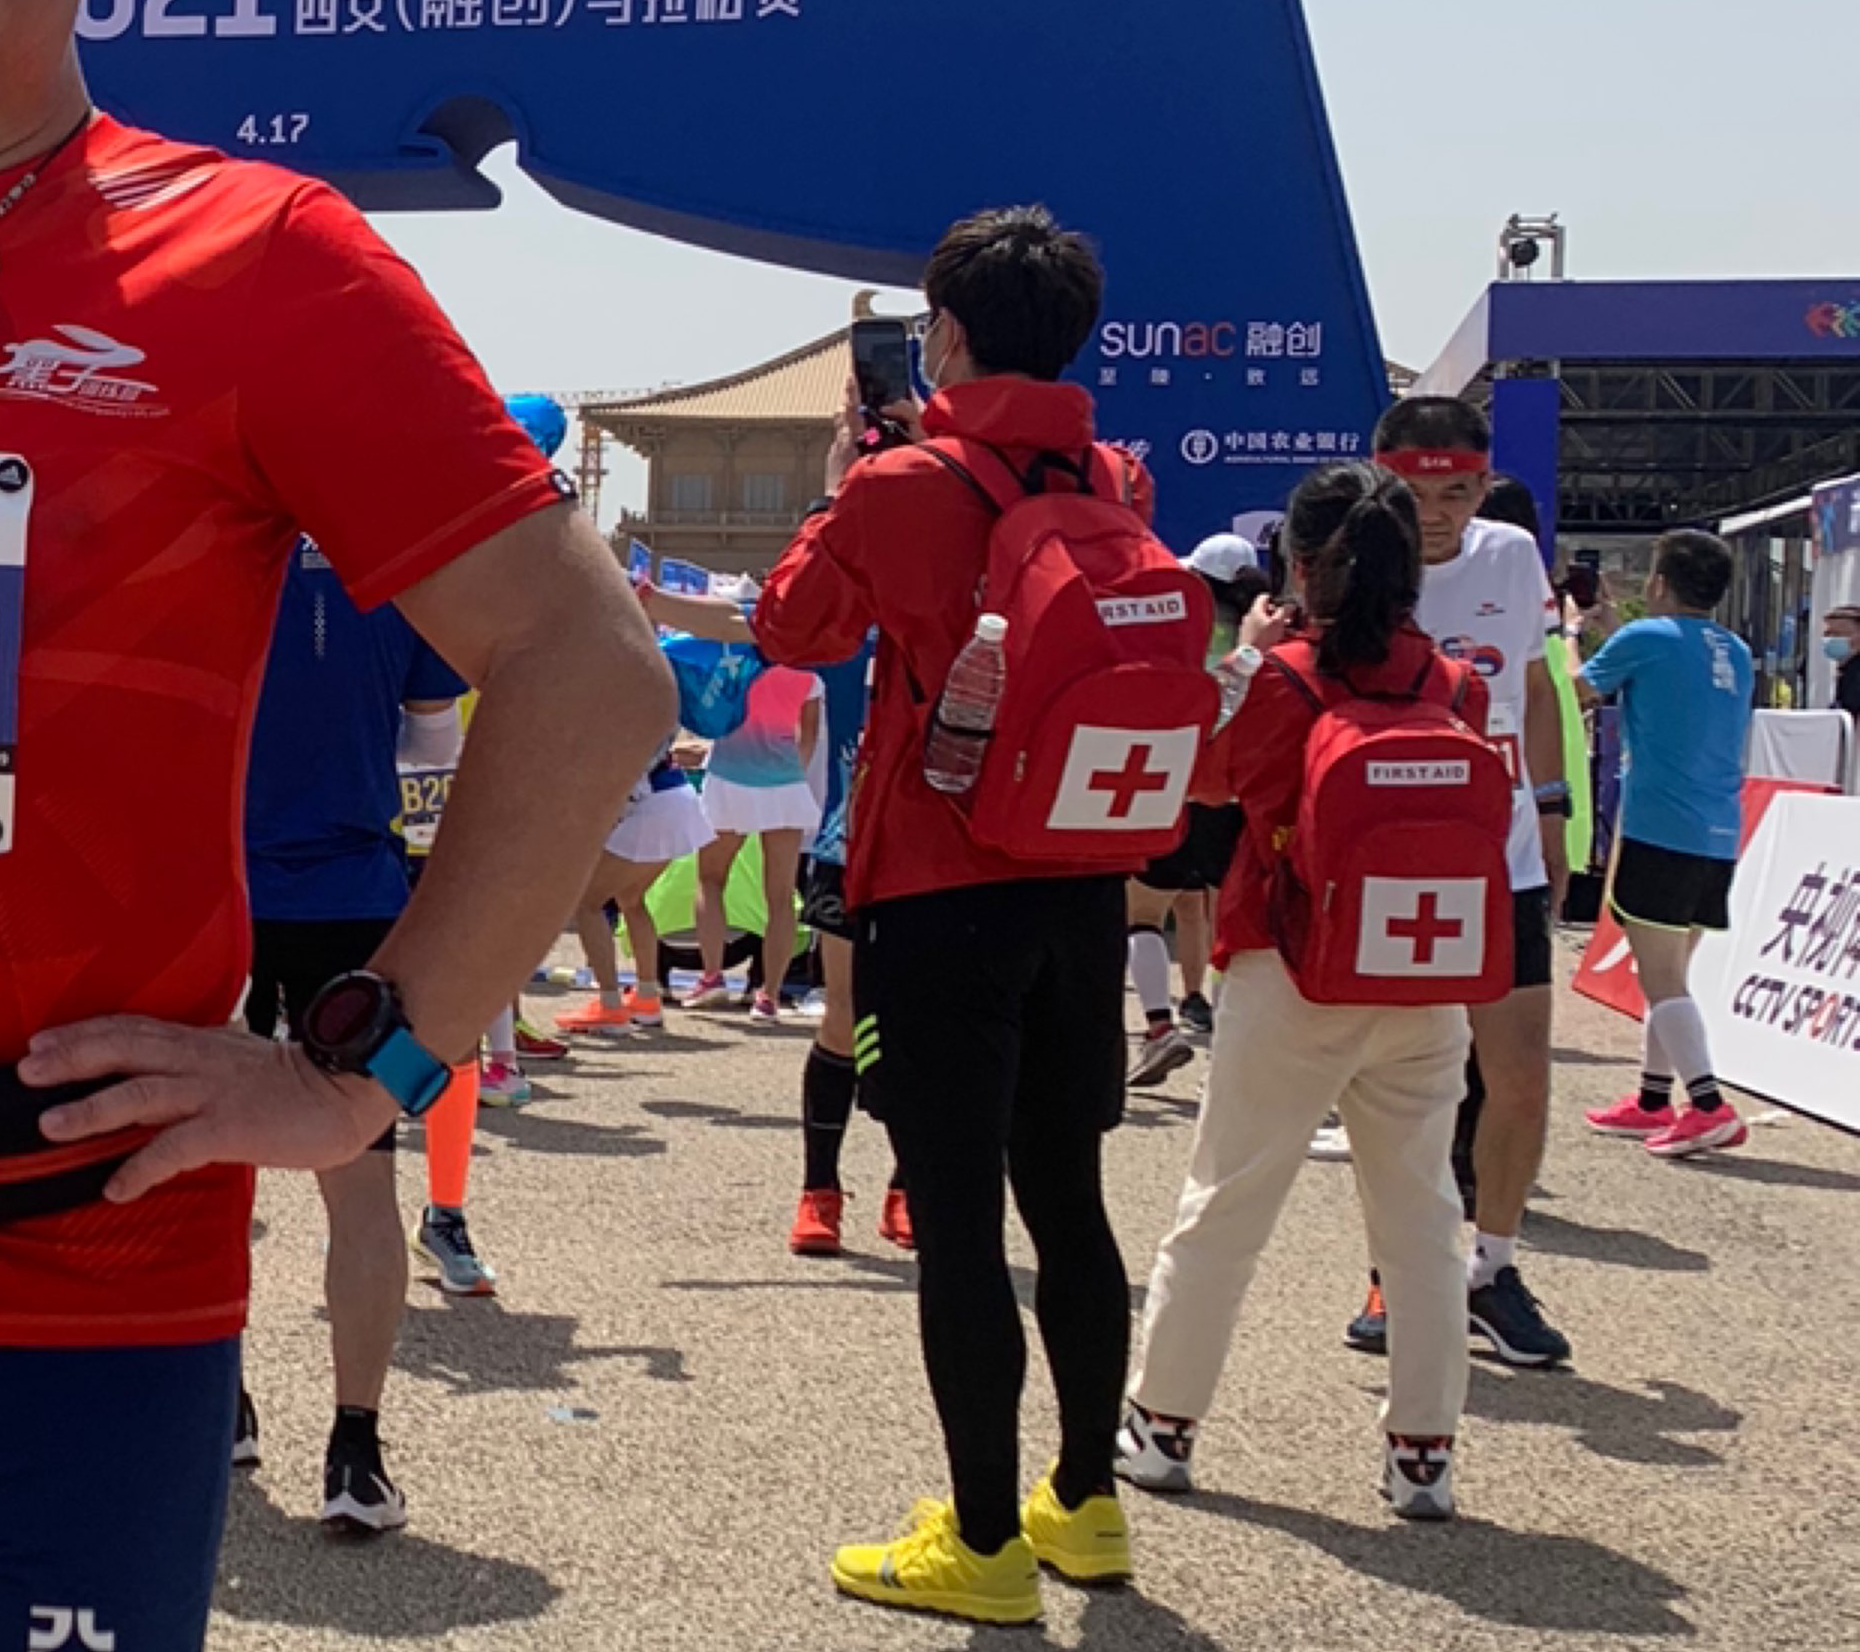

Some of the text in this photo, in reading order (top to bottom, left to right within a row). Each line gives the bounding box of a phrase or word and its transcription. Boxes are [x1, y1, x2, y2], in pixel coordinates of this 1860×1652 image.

[236, 114, 310, 144] 4.17
[1100, 321, 1236, 358] sunac
[1246, 321, 1322, 358] 融创
[1223, 430, 1360, 453] 中国农业银行
[1373, 765, 1465, 779] FIRST AID
[1733, 975, 1795, 1025] CCTV
